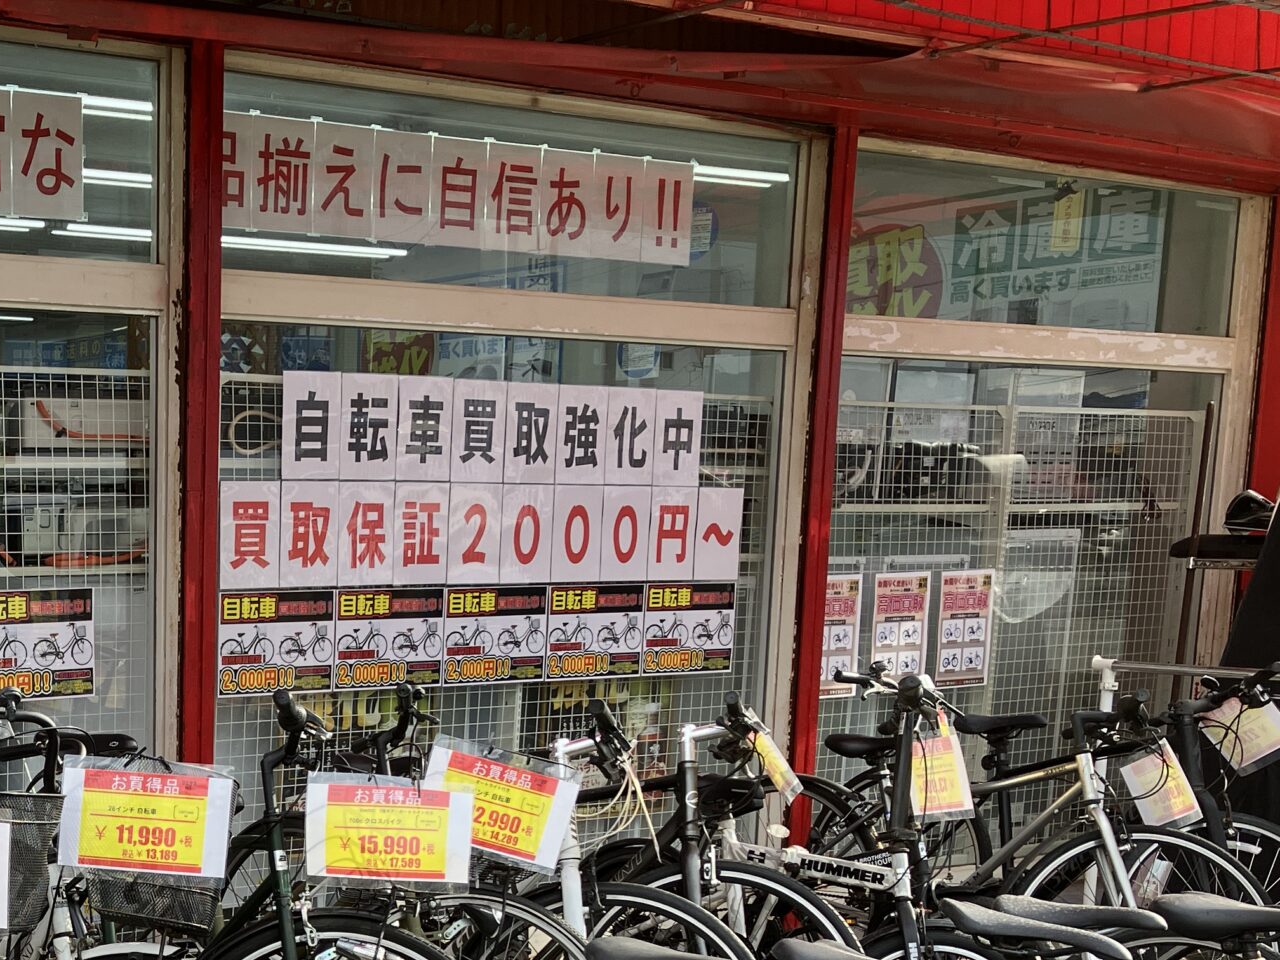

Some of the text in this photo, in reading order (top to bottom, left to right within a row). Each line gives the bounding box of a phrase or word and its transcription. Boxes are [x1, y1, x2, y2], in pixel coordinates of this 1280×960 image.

[294, 390, 694, 472] 自転車買取強化中
[223, 596, 277, 620] 自転車
[339, 594, 390, 616] 自転車
[448, 592, 496, 614] 自転車
[552, 590, 597, 611] 自転車
[649, 588, 691, 608] 自転車
[111, 774, 180, 795] お買得品
[472, 761, 532, 790] お買得品
[353, 788, 421, 806] お買得品
[115, 823, 177, 848] 11,990
[358, 834, 421, 856] 15,990
[800, 858, 885, 886] HUMMER
